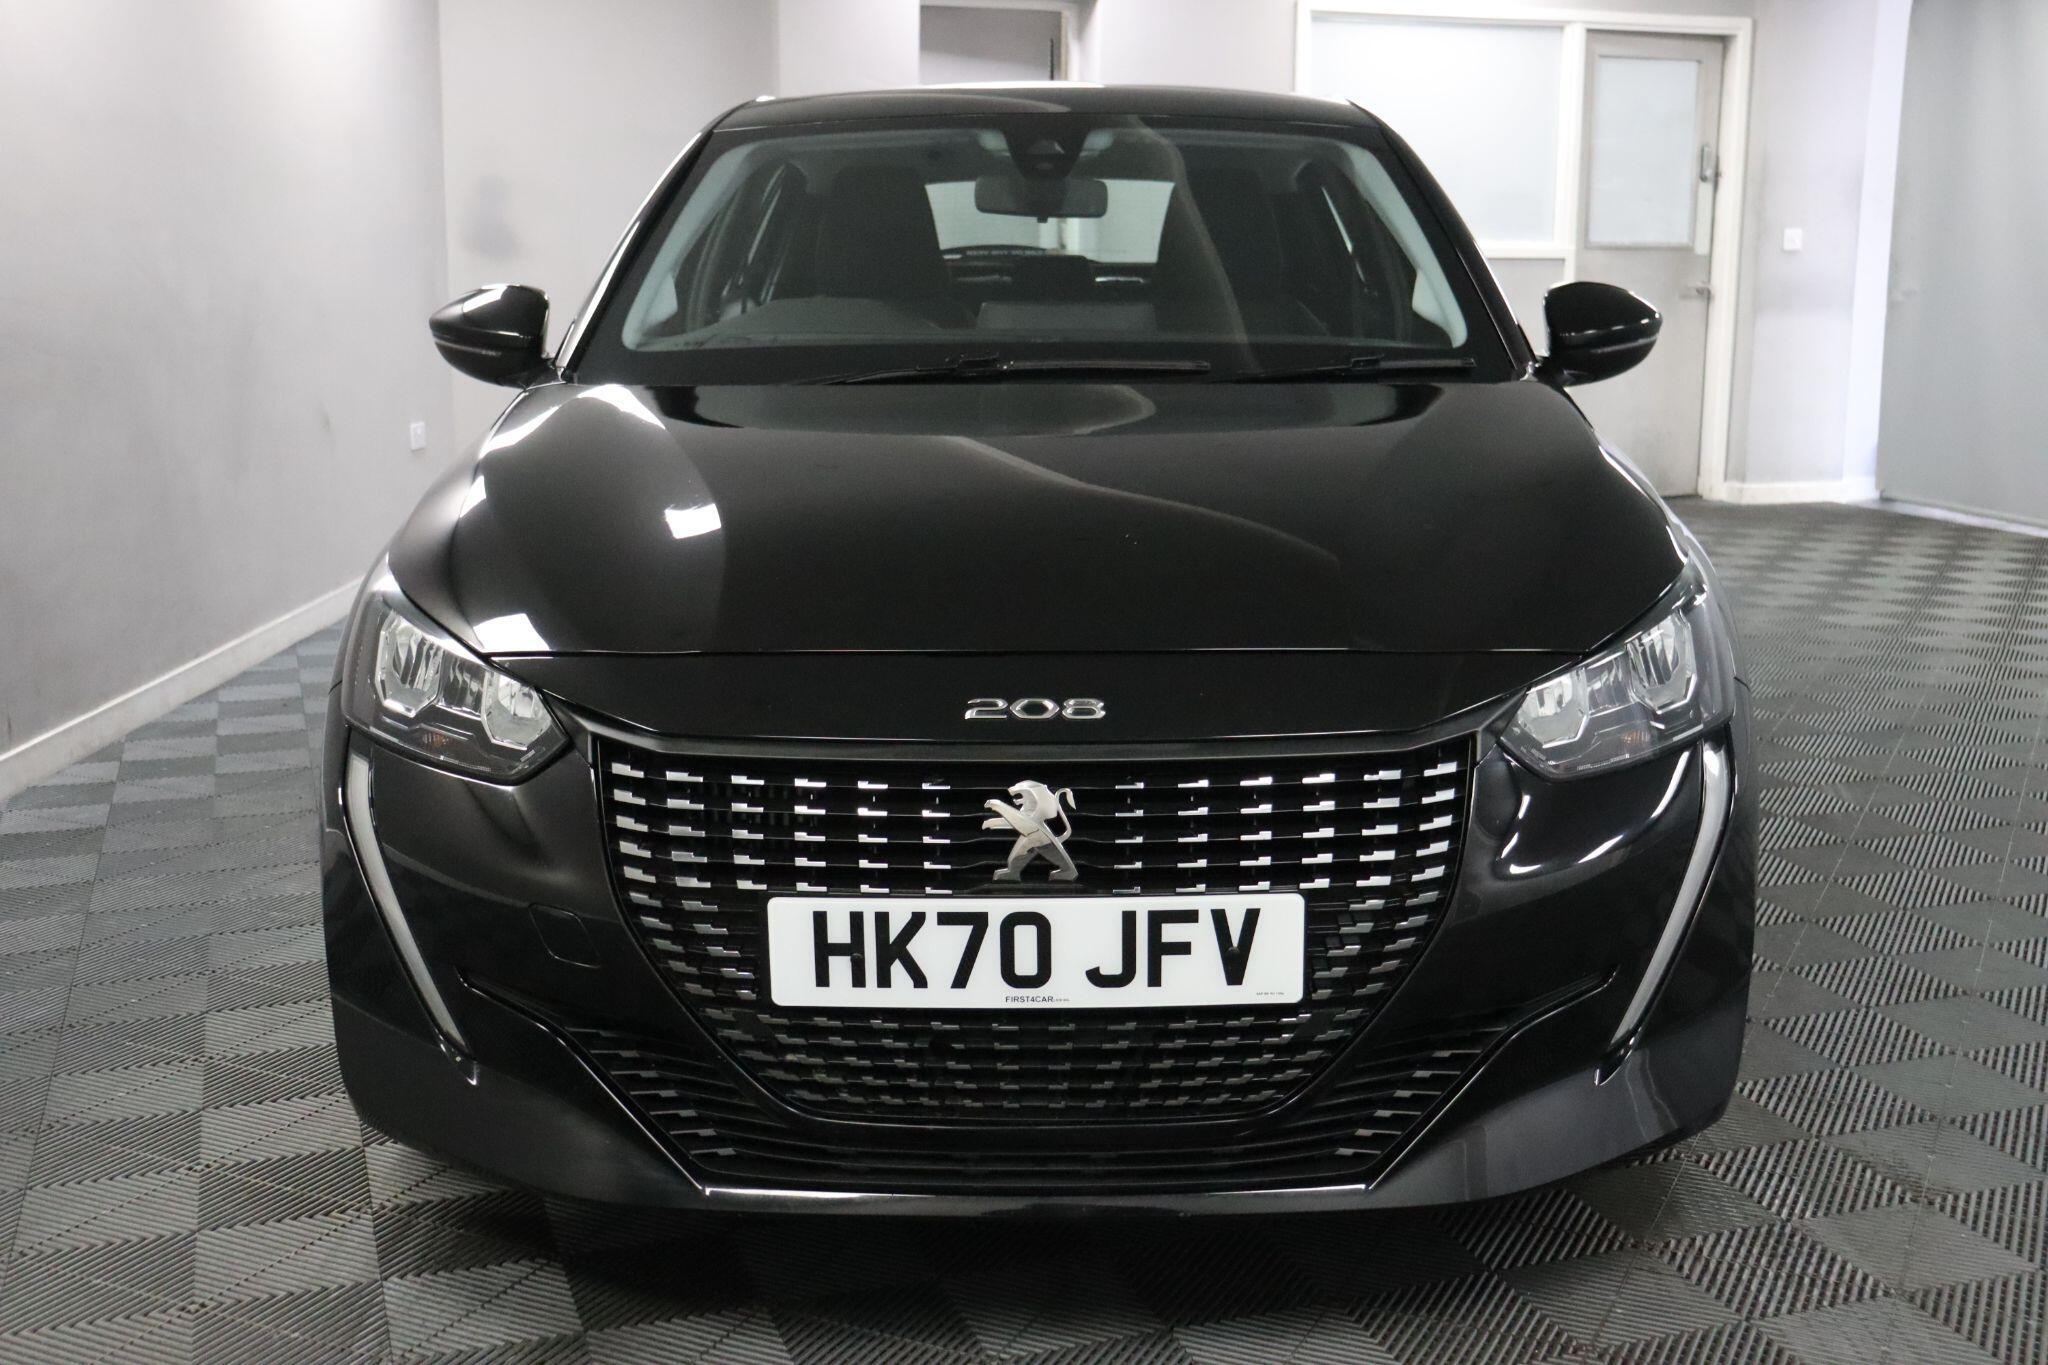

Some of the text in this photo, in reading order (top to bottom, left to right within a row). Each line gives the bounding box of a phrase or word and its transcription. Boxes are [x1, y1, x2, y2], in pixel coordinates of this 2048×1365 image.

[964, 697, 1106, 720] 208
[812, 907, 1261, 989] HK70 JFV
